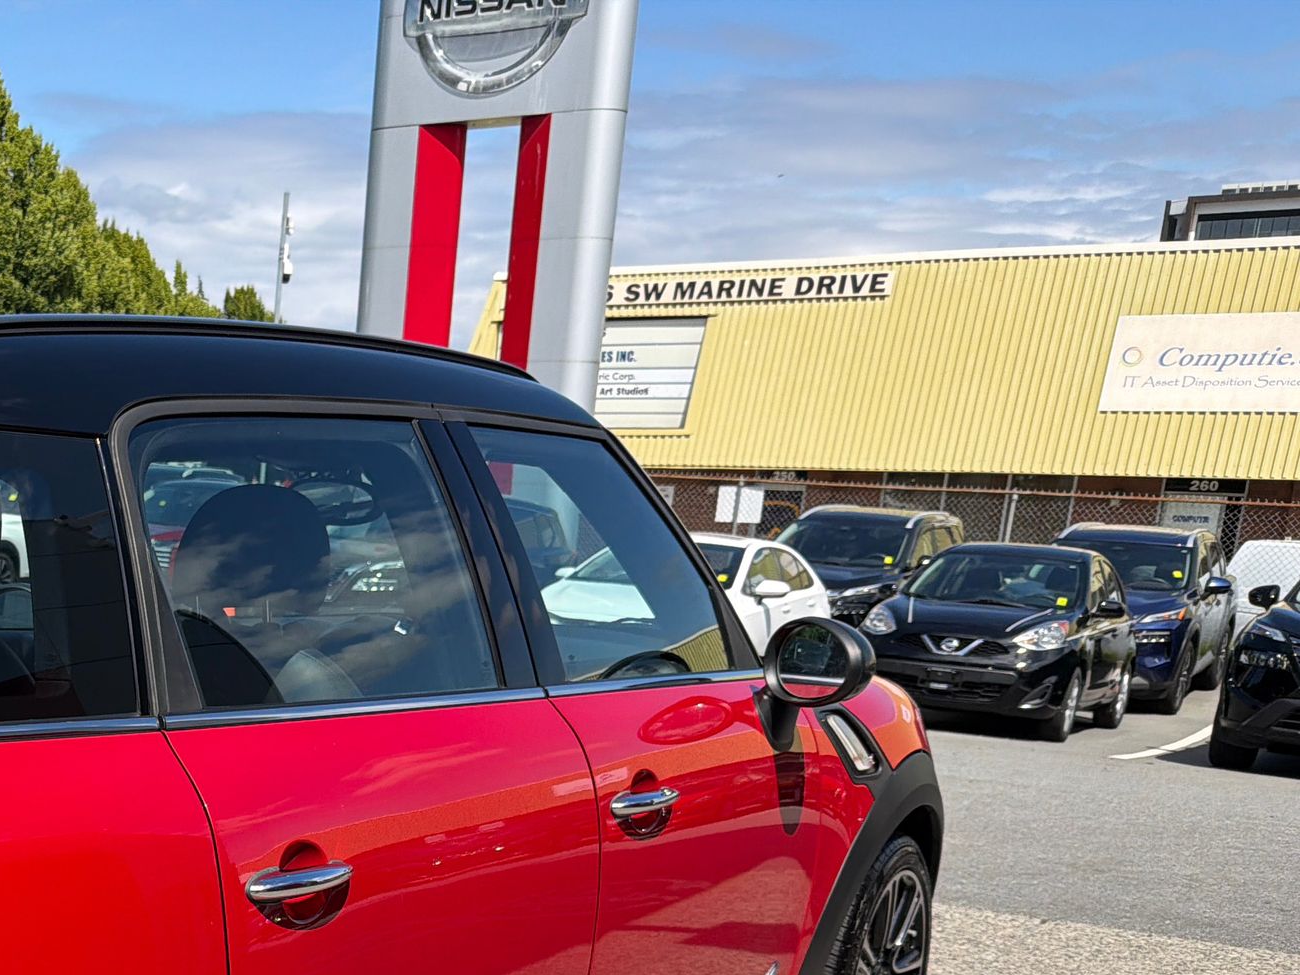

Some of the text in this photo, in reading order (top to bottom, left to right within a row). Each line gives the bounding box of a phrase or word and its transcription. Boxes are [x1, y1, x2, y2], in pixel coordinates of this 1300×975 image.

[417, 0, 567, 24] NISS
[623, 282, 668, 303] SW
[672, 278, 786, 300] MARINE
[794, 273, 888, 296] DRIVE
[1158, 346, 1300, 372] Computie.
[599, 387, 613, 395] Art
[1122, 375, 1141, 388] IT
[1182, 375, 1252, 391] Disposition
[1189, 480, 1219, 491] 260
